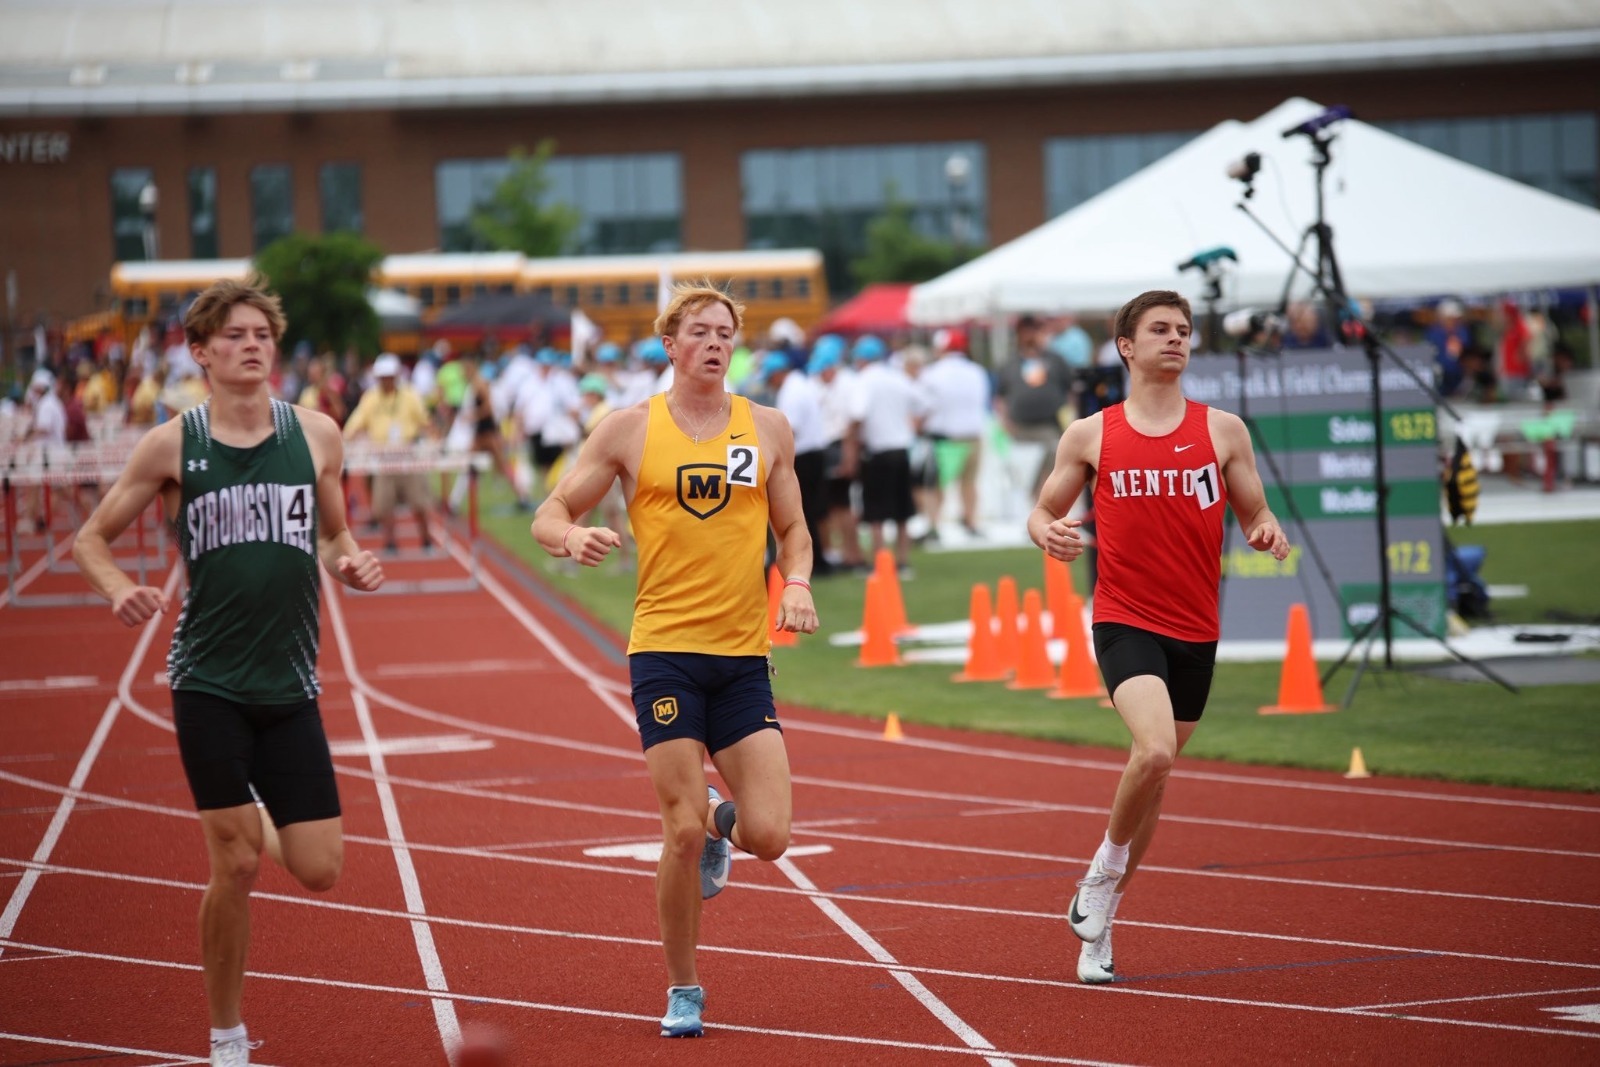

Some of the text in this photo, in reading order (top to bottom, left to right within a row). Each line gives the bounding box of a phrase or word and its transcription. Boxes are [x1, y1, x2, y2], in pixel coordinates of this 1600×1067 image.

[730, 447, 753, 483] 2
[687, 475, 721, 499] M
[1110, 469, 1196, 498] MENTO
[1197, 468, 1214, 503] 1
[187, 483, 314, 561] STRONGSV
[286, 488, 307, 527] 4
[656, 702, 674, 717] M
